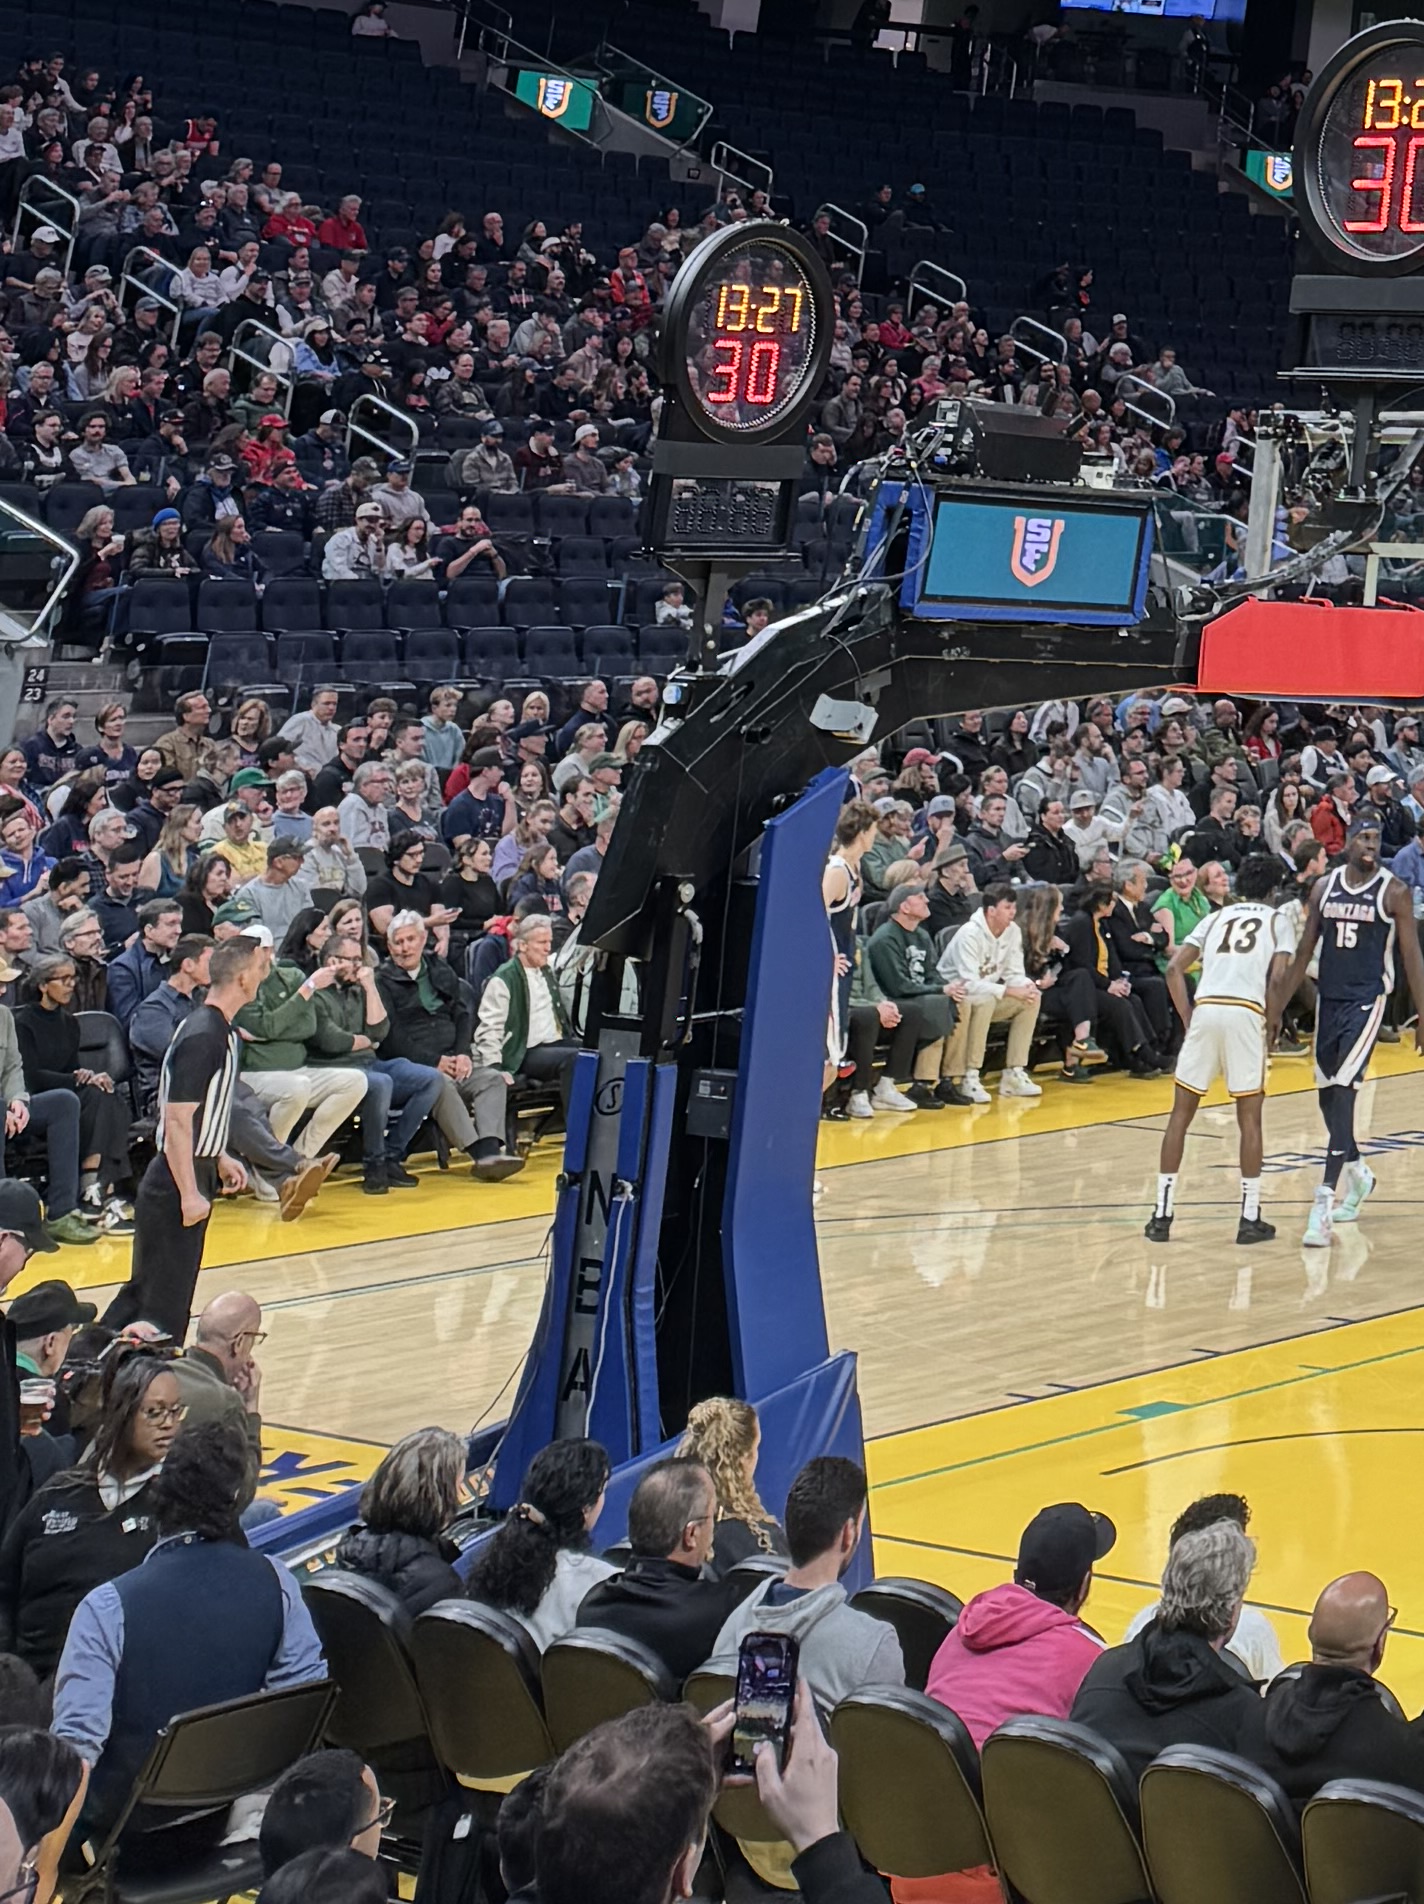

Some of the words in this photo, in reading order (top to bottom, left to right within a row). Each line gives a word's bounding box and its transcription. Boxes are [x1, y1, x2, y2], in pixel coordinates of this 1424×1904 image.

[717, 284, 802, 334] 13:27
[709, 340, 781, 406] 30
[1323, 902, 1375, 922] GONZAGA
[1216, 916, 1263, 954] 13
[1336, 922, 1358, 948] 15
